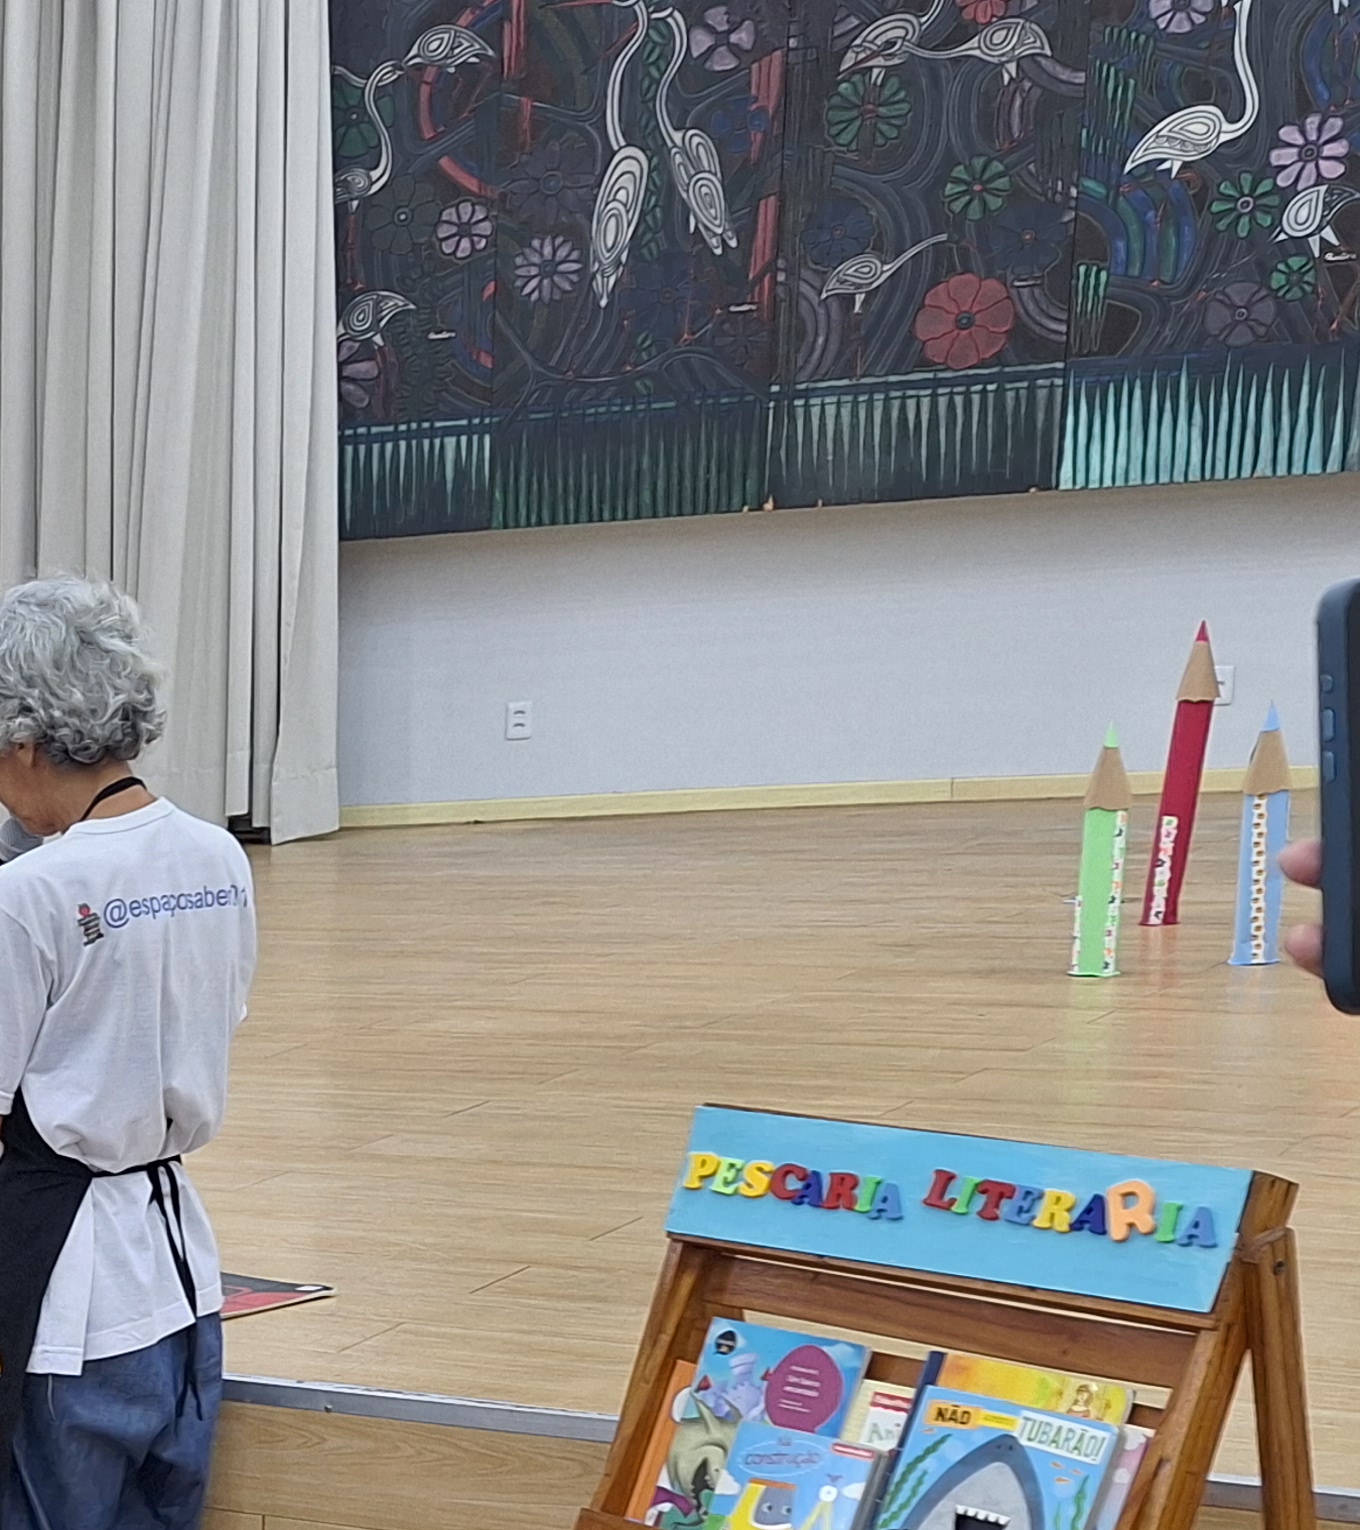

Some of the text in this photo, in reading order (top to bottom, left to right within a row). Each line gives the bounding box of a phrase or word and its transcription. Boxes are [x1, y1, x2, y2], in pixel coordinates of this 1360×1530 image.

[683, 1151, 1217, 1249] PESCARIA LITERARIA
[934, 1404, 1105, 1462] NÃO TUBARÃO!
